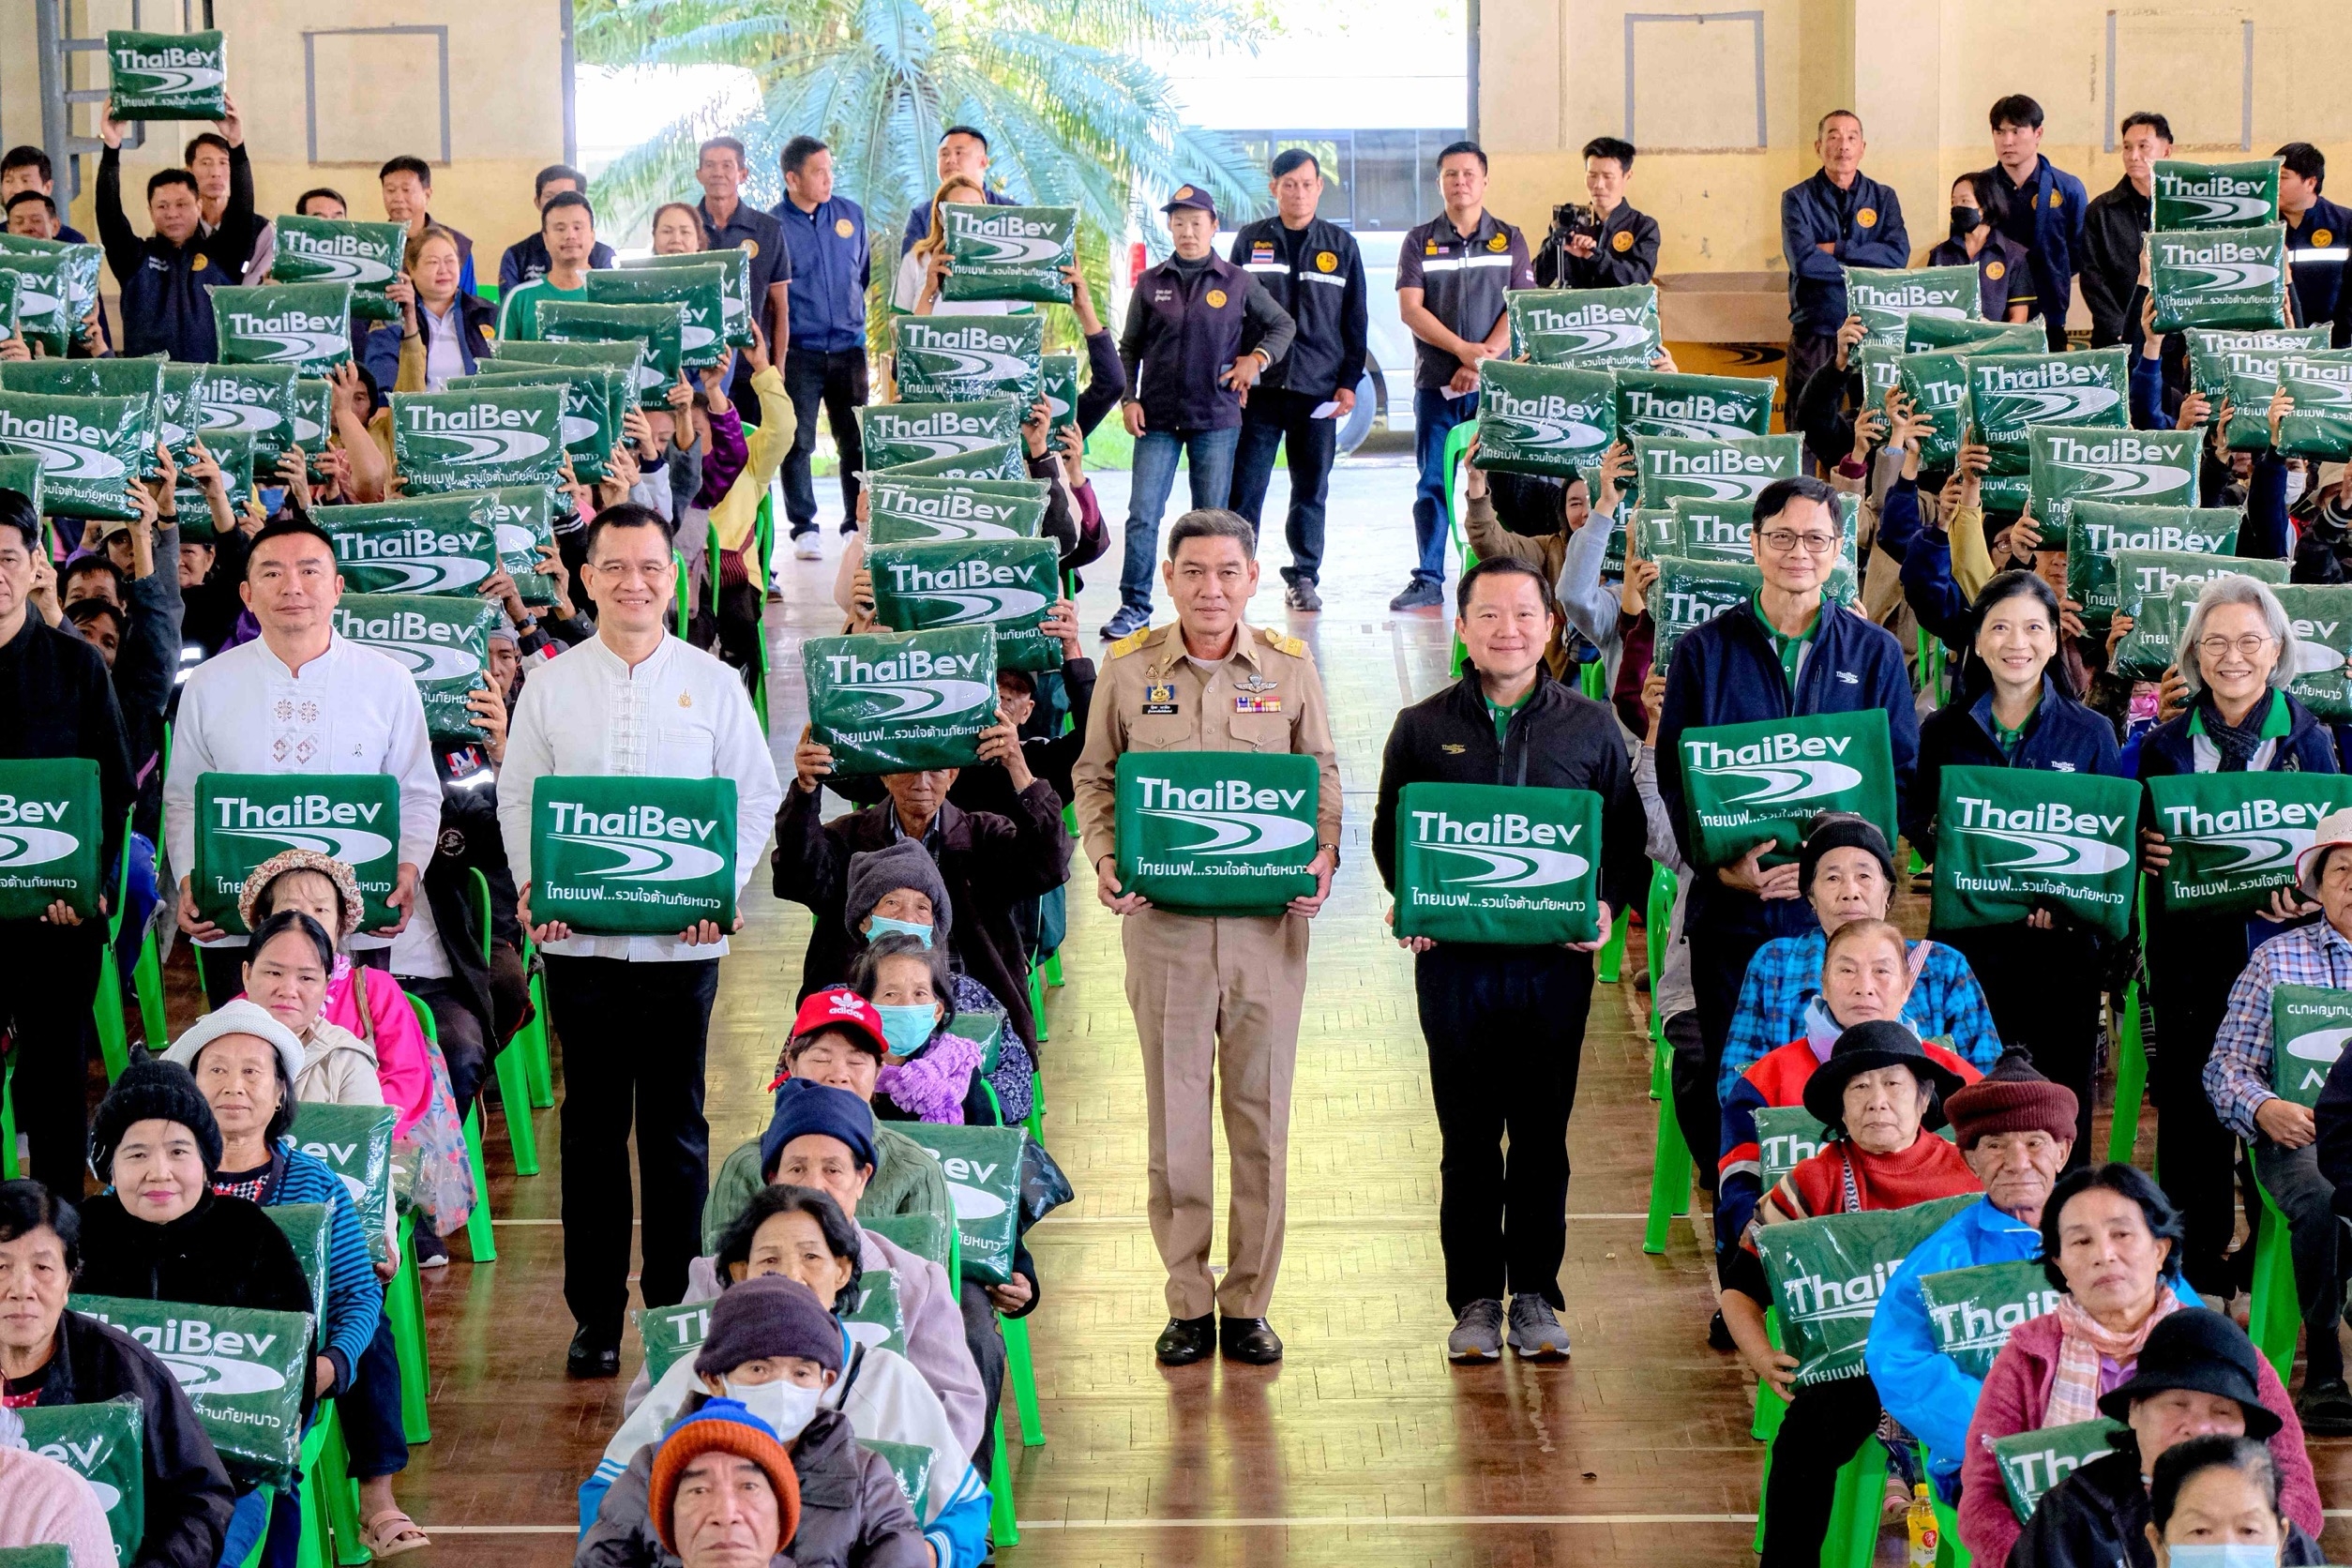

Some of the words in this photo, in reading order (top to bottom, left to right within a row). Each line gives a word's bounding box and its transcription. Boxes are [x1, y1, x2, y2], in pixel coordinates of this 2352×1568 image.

[115, 48, 218, 68] ThaiBev
[2161, 176, 2267, 196] ThaiBev
[952, 211, 1057, 236] ThaiBev
[284, 231, 389, 257] ThaiBev
[2162, 242, 2272, 264] ThaiBev
[1854, 285, 1959, 307] ThaiBev
[229, 311, 342, 335] ThaiBev
[1528, 304, 1643, 331] ThaiBev
[905, 324, 1025, 353] ThaiBev
[1978, 361, 2109, 389] ThaiBev
[2283, 362, 2352, 382] Thai
[405, 404, 542, 430] ThaiBev
[1486, 390, 1604, 420] ThaiBev
[1626, 391, 1757, 423] ThaiBev
[874, 412, 1000, 437] ThaiBev
[1648, 449, 1785, 474] ThaiBev
[2047, 437, 2183, 461] ThaiBev
[877, 488, 1017, 520] ThaiBev
[333, 530, 481, 559] ThaiBev
[2085, 523, 2226, 553] ThaiBev
[888, 561, 1036, 592] ThaiBev
[826, 651, 980, 684] ThaiBev
[1685, 733, 1851, 767] ThaiBev
[1137, 776, 1306, 811] ThaiBev
[213, 795, 383, 827] ThaiBev
[549, 802, 718, 841] ThaiBev
[1957, 796, 2125, 837] ThaiBev
[2164, 800, 2331, 835] ThaiBev
[1412, 811, 1582, 846] ThaiBev
[547, 882, 721, 909] ไทยเบฟ...รวมใจต้านภัยหนาว
[1411, 887, 1586, 912] ไทยเบฟ...รวมใจต้านภัยหนาว
[1953, 872, 2124, 904] ไทยเบฟ...รวมใจต้านภัยหนาว
[2173, 873, 2299, 898] ไทยเบฟ...รวมใจต้าน
[829, 1006, 865, 1020] adidas
[1784, 1259, 1905, 1315] Thai
[1930, 1290, 2062, 1344] Thai
